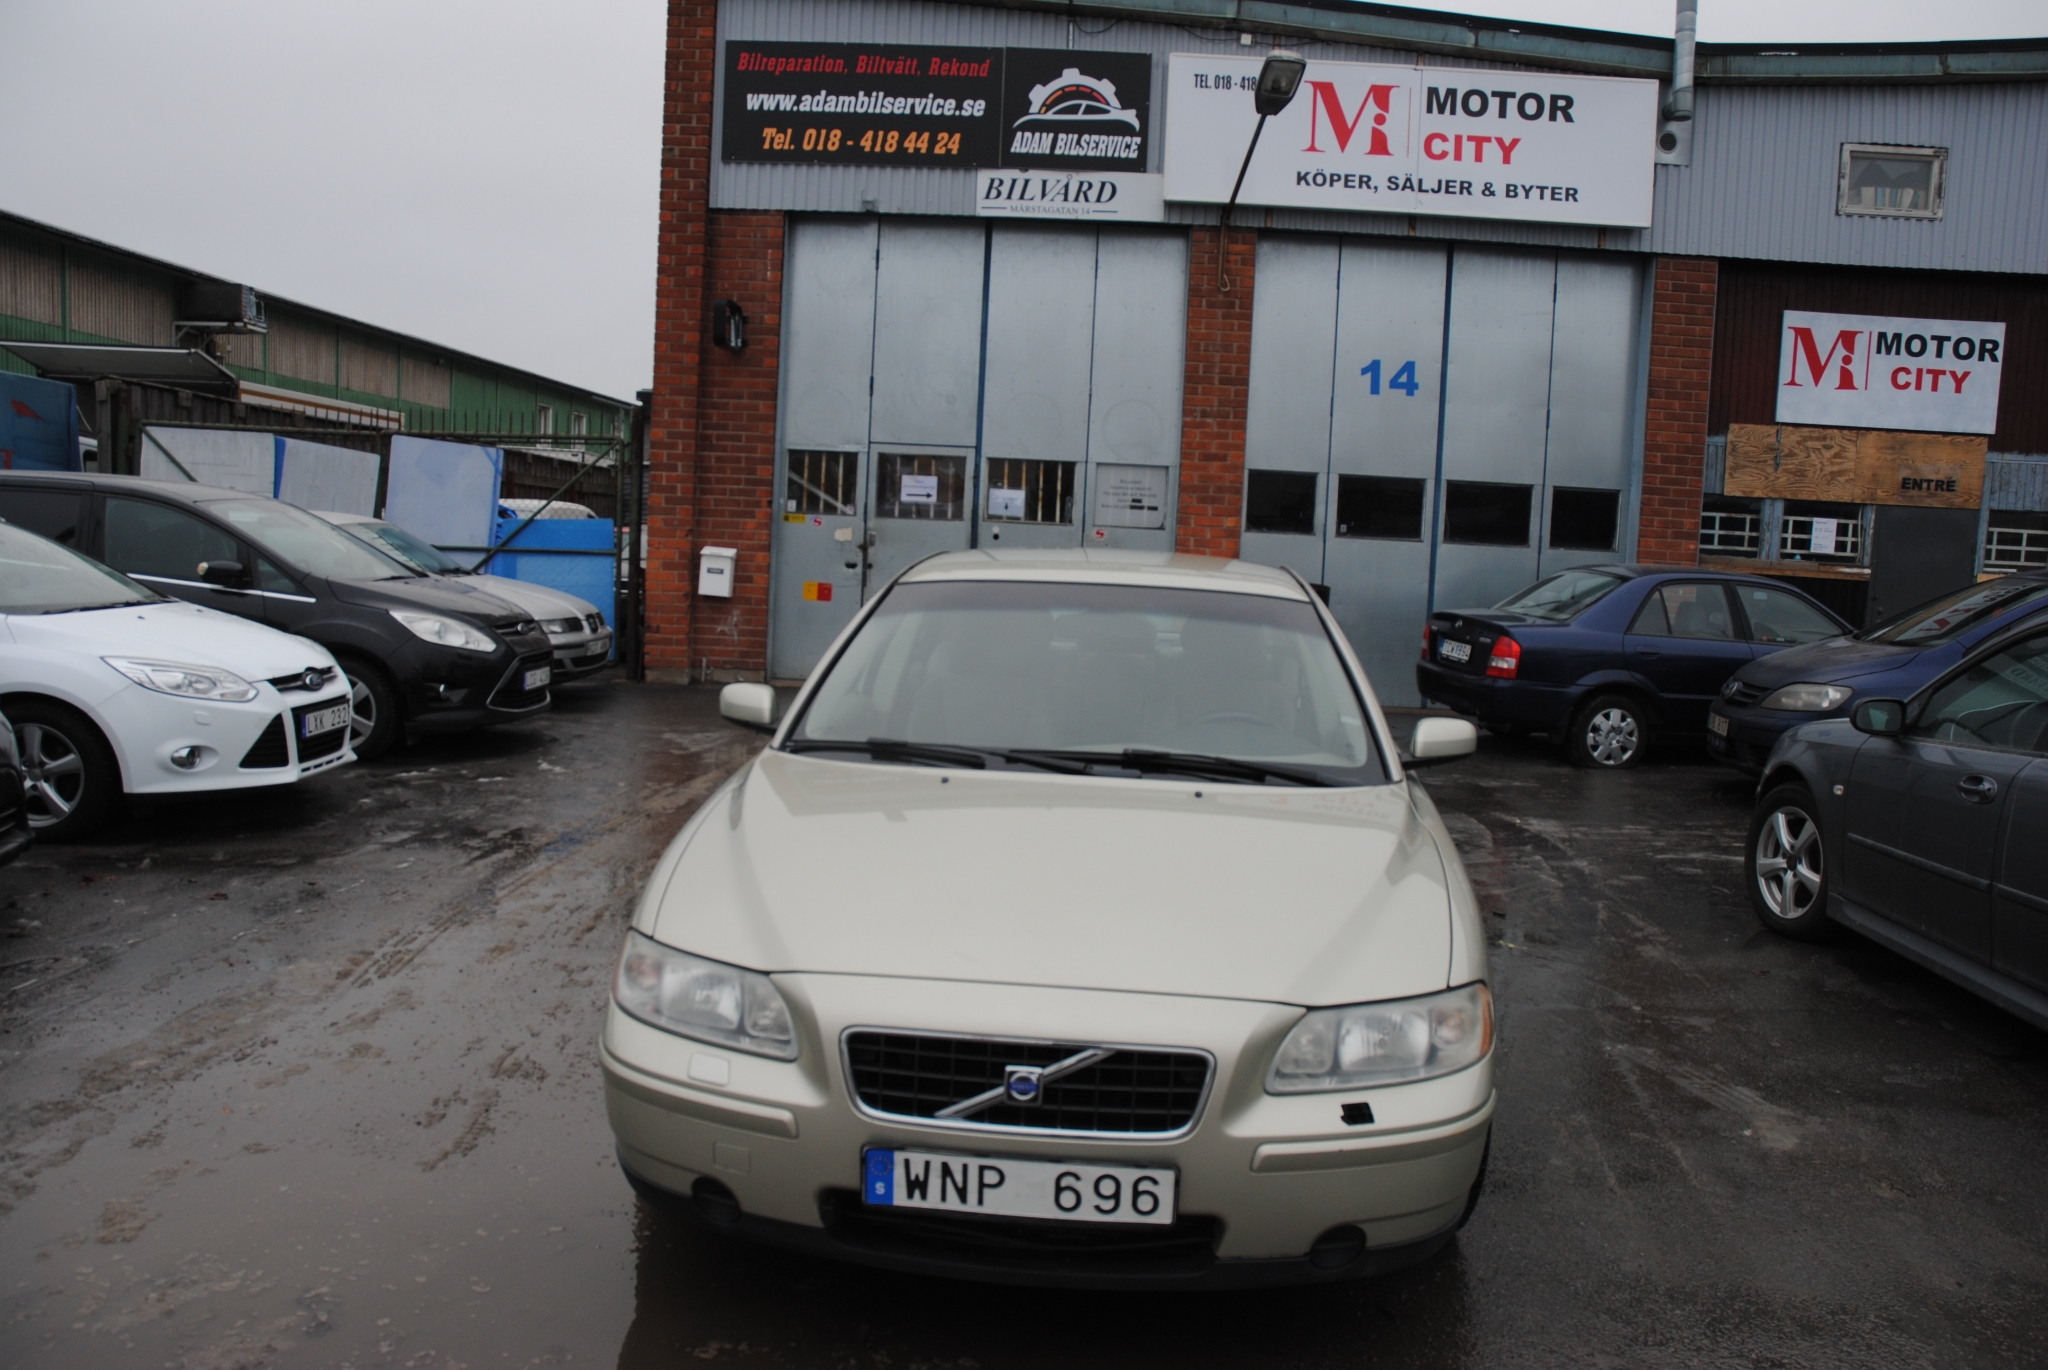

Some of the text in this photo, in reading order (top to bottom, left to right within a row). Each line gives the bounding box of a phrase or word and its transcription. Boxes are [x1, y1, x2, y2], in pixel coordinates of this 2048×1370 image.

[737, 52, 990, 77] Bilreparation, Biltvätt, Rekond
[1194, 73, 1212, 89] TEL.
[1214, 74, 1232, 90] 018
[1240, 76, 1257, 91] 418
[746, 90, 986, 117] www.adambilservice.se
[1425, 86, 1575, 123] MOTOR
[762, 127, 795, 150] Tel.
[802, 128, 839, 151] 018
[860, 128, 900, 153] 418
[903, 130, 929, 154] 44
[934, 132, 961, 155] 24
[1010, 130, 1141, 159] ADAM BILSERVICE
[1424, 132, 1522, 165] CITY
[983, 174, 1118, 203] BILVÅRD
[1296, 168, 1579, 202] KÖPER, SÄLJER & BYTER
[1081, 207, 1090, 215] 14
[1876, 331, 2000, 363] MOTOR
[1360, 359, 1419, 397] 14
[1890, 366, 1972, 394] CITY
[1901, 475, 1957, 493] ENTRÉ
[307, 706, 347, 733] LXK 232
[874, 1182, 885, 1195] S
[904, 1158, 1160, 1216] WNP 696
